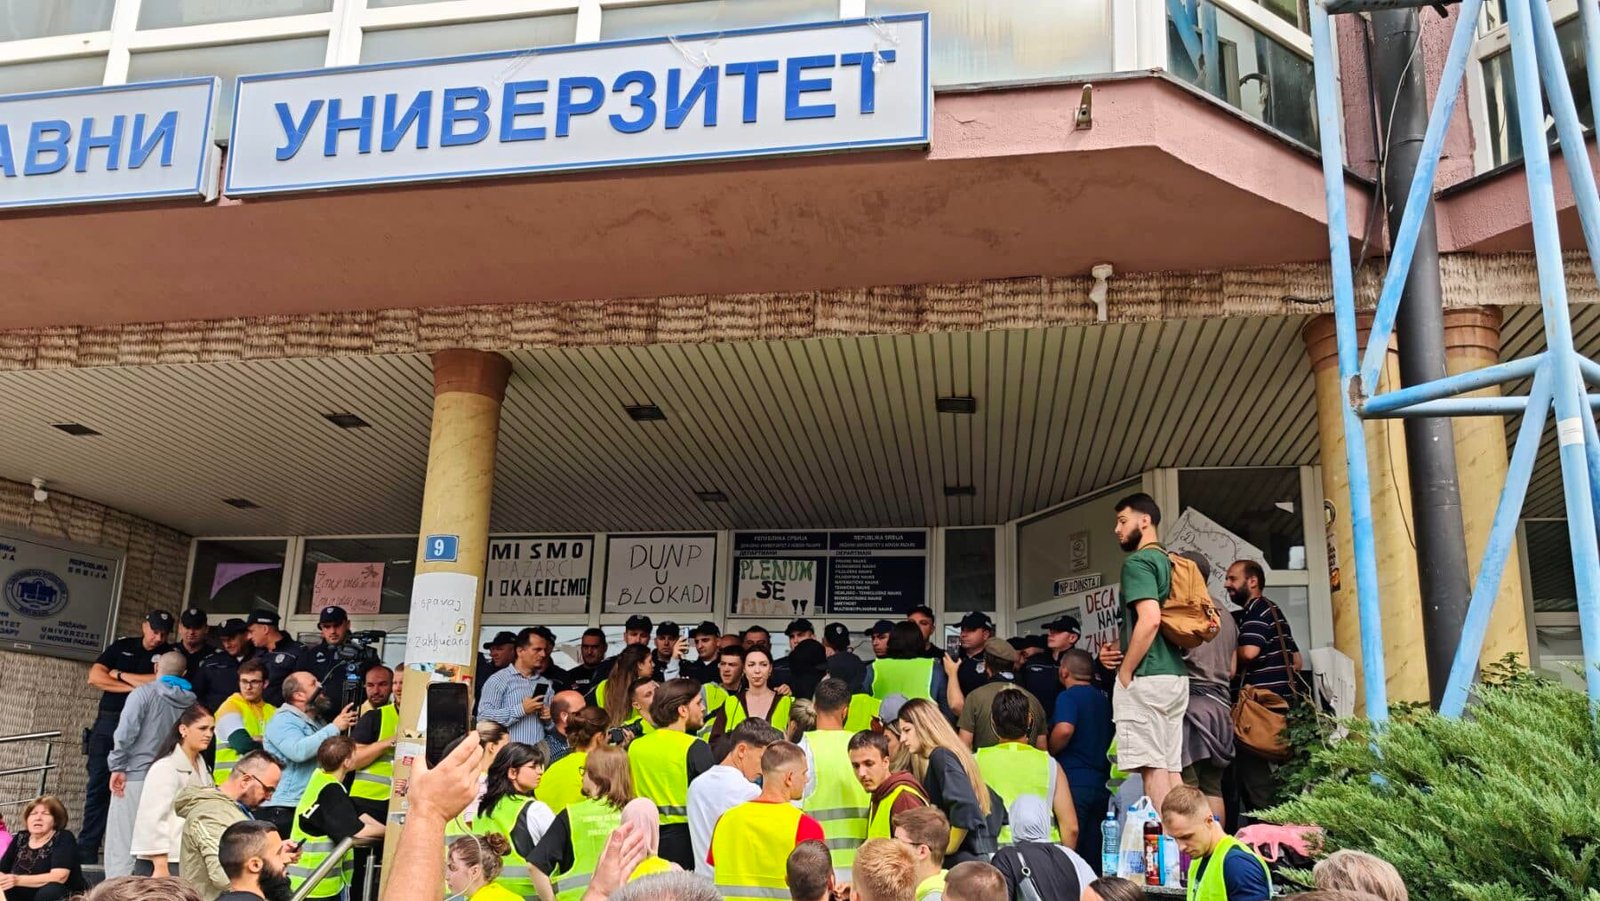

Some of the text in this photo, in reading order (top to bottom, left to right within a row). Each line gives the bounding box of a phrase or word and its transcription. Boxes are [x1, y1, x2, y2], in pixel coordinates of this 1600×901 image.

[274, 49, 897, 162] УНИВЕРЗИТЕТ
[434, 539, 444, 556] 9
[492, 542, 584, 560] MI SMO
[630, 544, 702, 570] DUNP
[498, 560, 574, 577] PAZARCI
[655, 570, 668, 585] U
[741, 559, 813, 581] PLENUM
[488, 580, 493, 597] I
[618, 584, 711, 606] BLOKADI
[756, 580, 786, 601] SE
[499, 598, 560, 612] BANER
[1085, 587, 1116, 614] DECA
